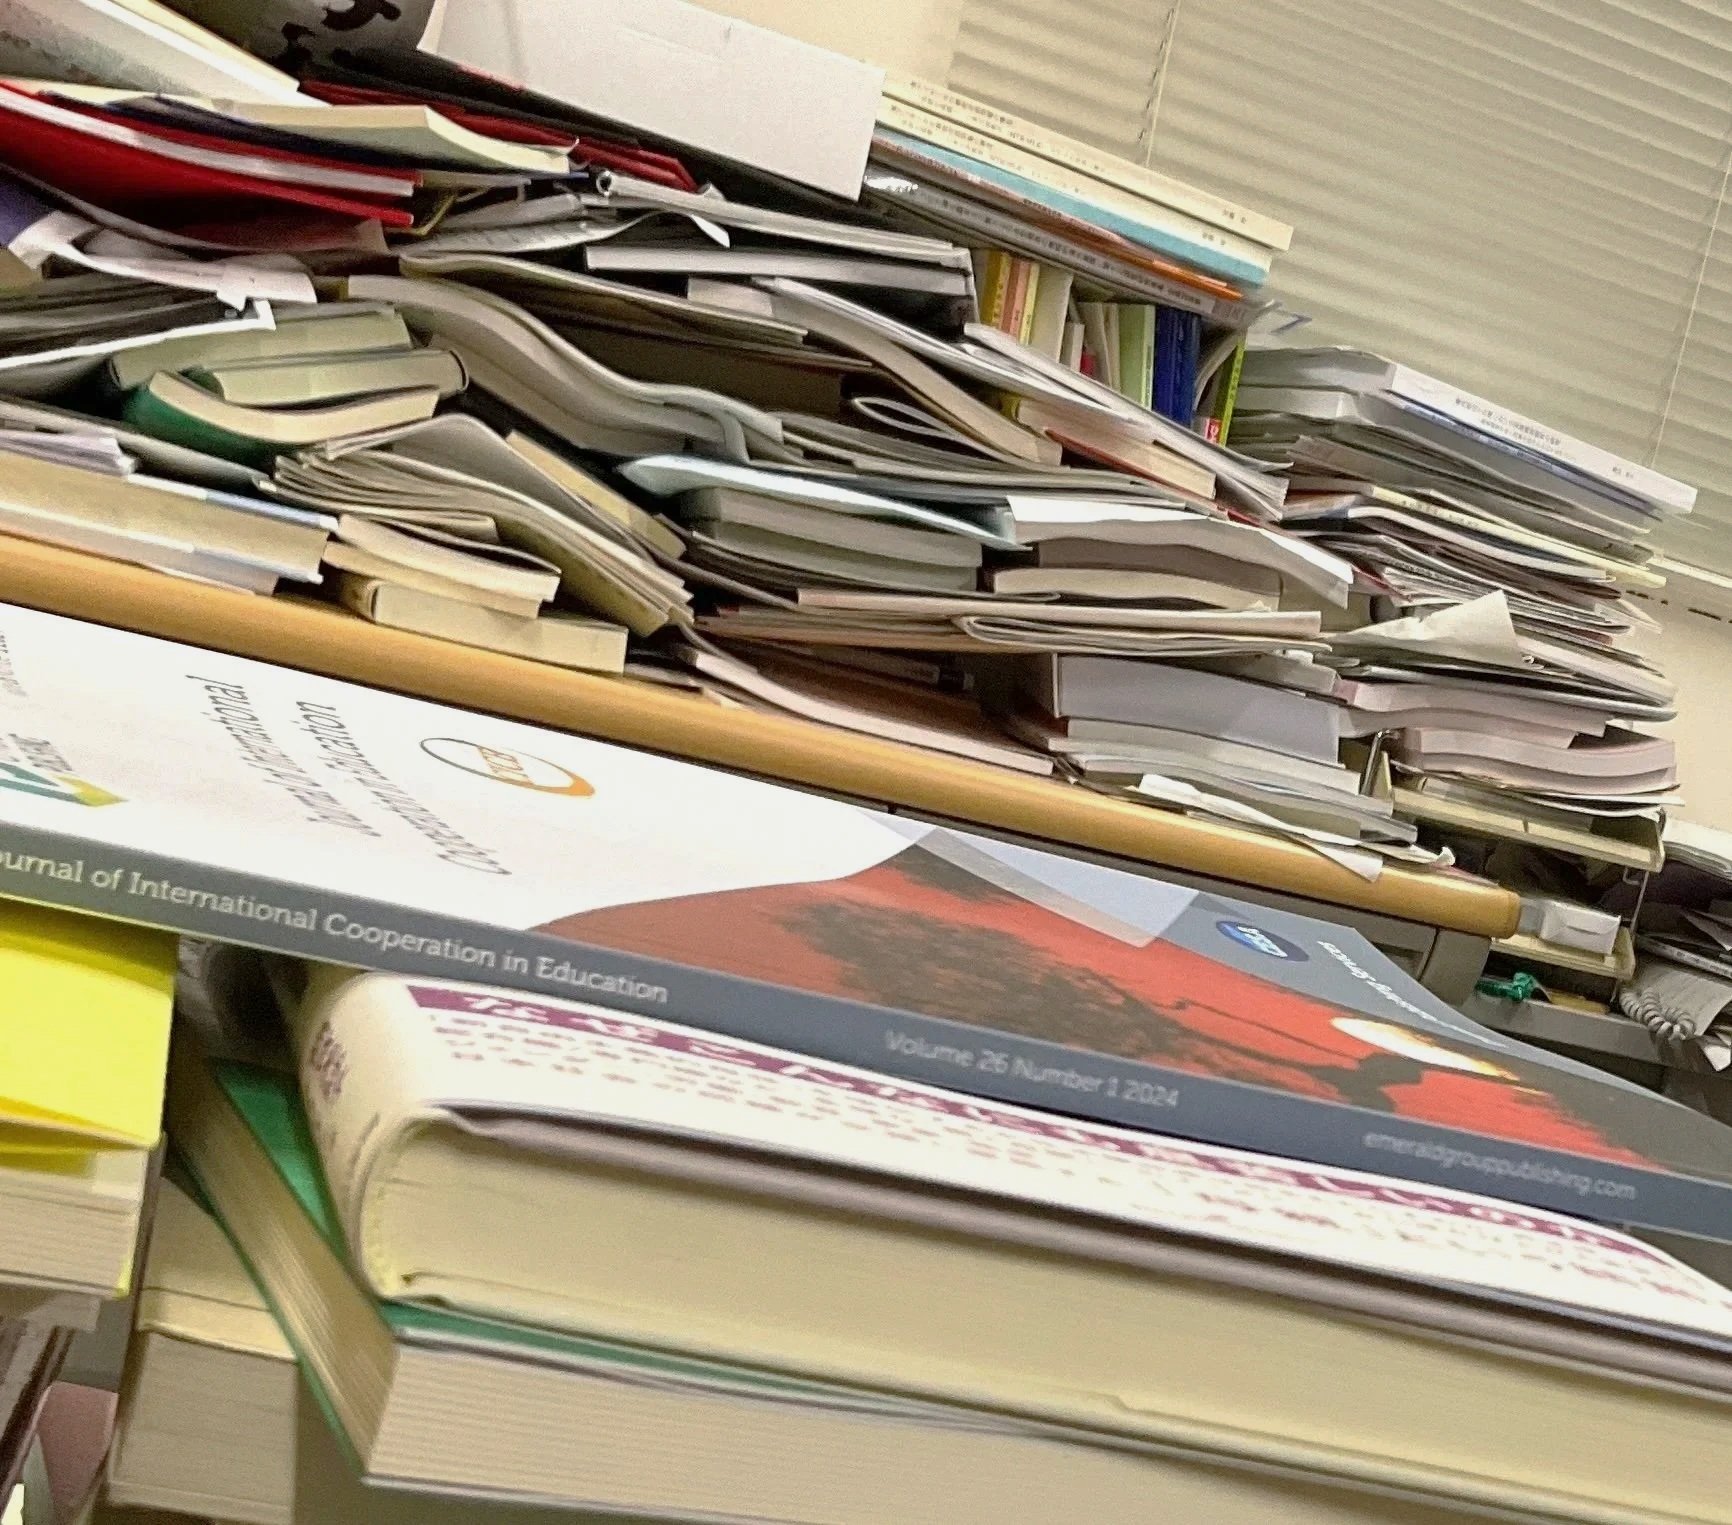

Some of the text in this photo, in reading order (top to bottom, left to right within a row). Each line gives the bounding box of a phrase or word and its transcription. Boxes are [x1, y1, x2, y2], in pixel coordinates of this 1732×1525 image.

[0, 849, 669, 1004] urnal of International Cooperation in Education
[884, 1030, 1180, 1109] Volume 26 Number 1 2024
